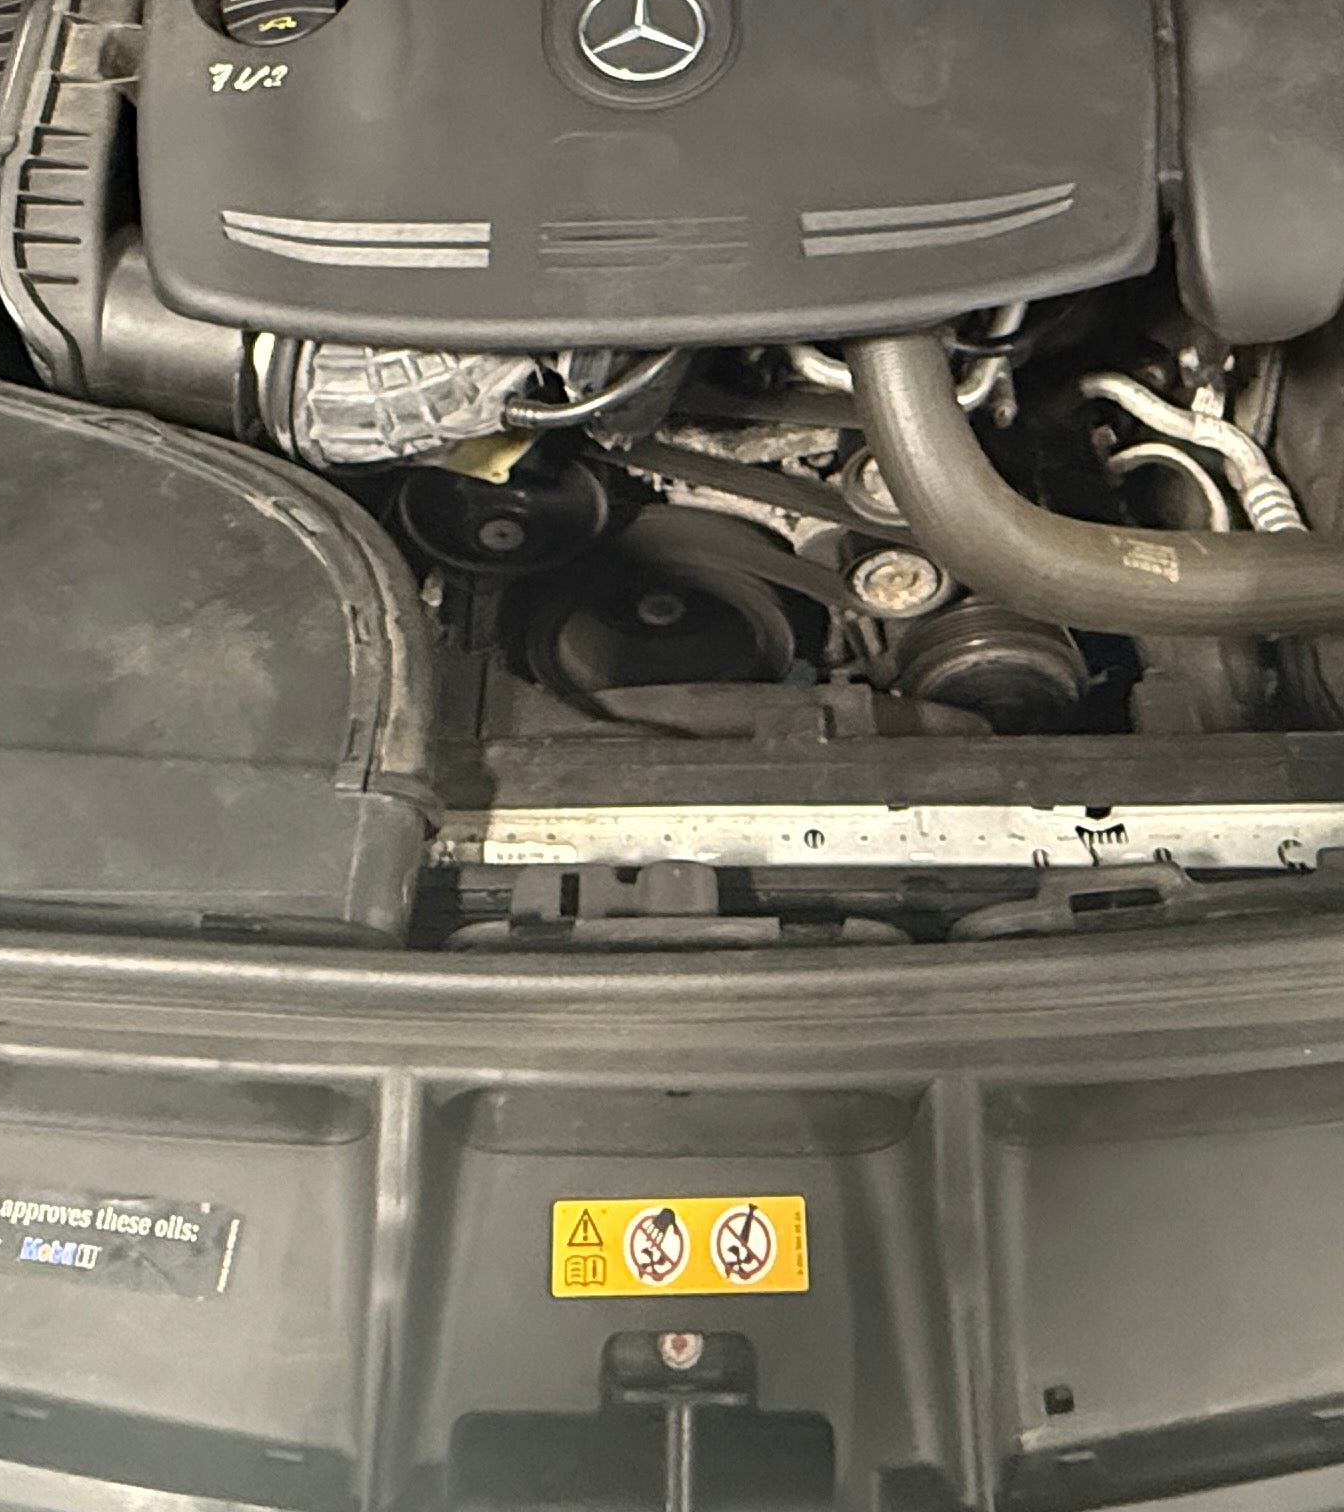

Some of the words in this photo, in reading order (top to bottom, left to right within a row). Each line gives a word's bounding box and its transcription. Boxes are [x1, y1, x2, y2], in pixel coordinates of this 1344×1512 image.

[0, 1199, 93, 1230] approves
[95, 1207, 152, 1236] these
[154, 1214, 200, 1242] oils:
